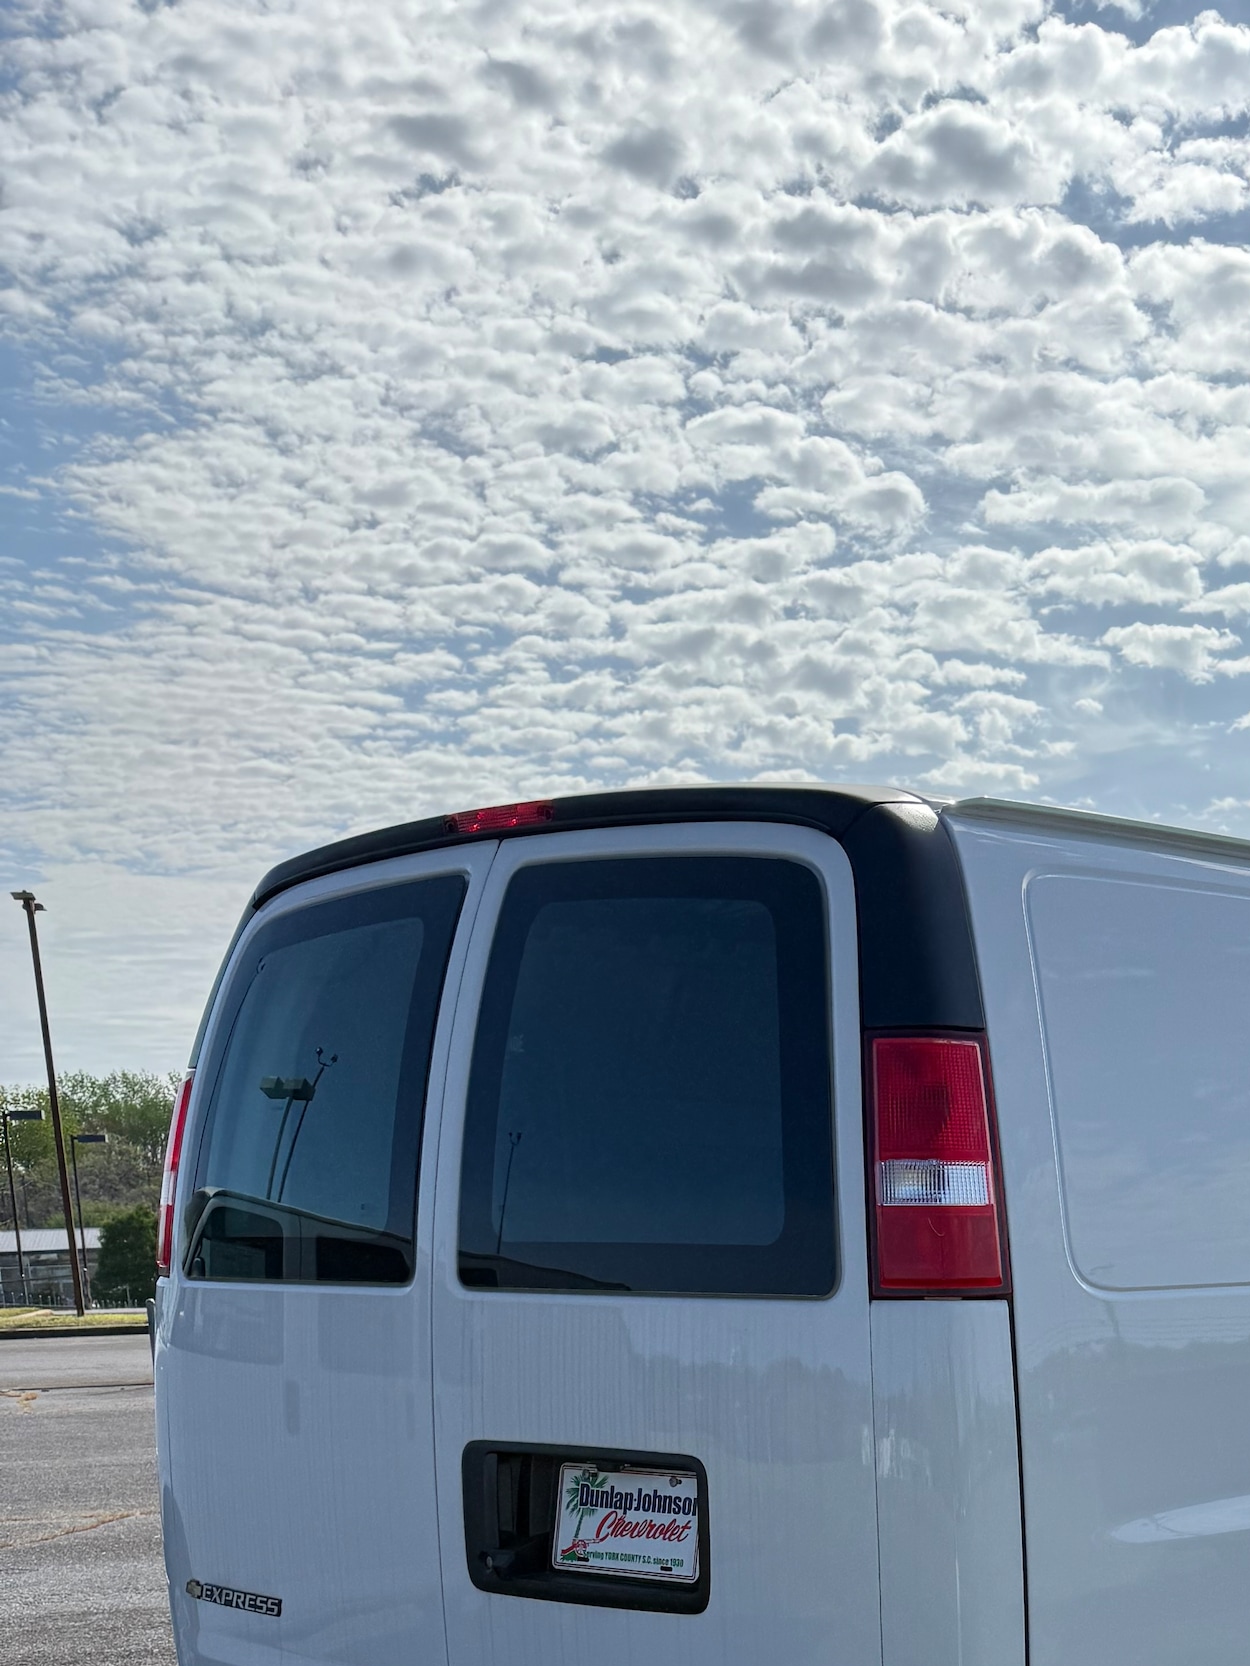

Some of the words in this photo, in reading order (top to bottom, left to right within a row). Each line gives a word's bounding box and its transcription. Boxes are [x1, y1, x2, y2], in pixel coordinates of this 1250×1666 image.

[595, 1510, 692, 1543] Chevrolet
[605, 1552, 619, 1561] YORK
[620, 1552, 641, 1564] COUNTY
[653, 1556, 669, 1566] since
[201, 1584, 281, 1616] EXPRESS
